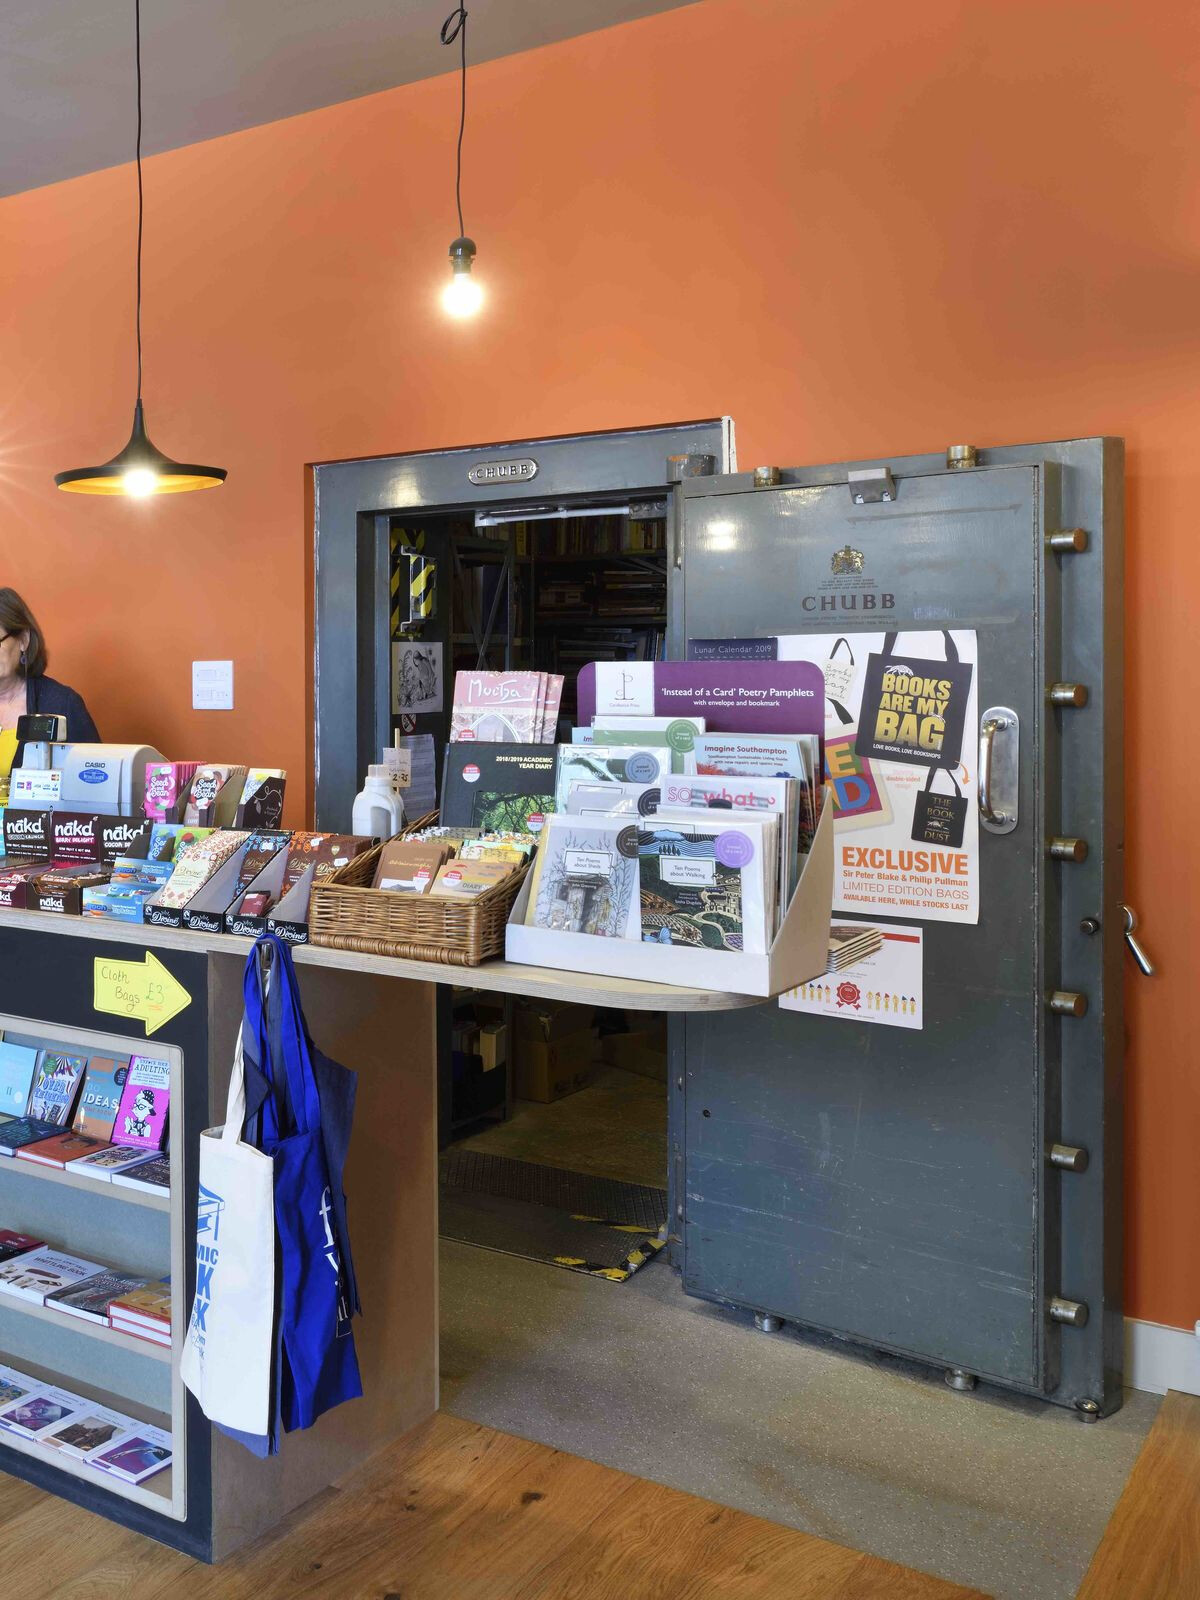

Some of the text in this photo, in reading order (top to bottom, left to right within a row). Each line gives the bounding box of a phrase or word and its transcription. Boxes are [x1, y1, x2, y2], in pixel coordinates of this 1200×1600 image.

[475, 463, 530, 480] CHUBB
[801, 593, 896, 612] CHUBB
[694, 645, 772, 654] Lunar Calendar 2019
[694, 686, 704, 697] of
[738, 687, 767, 698] Poetry
[770, 687, 814, 700] Pamphlets
[881, 672, 952, 700] BOOKS
[708, 700, 734, 708] envelope
[879, 692, 948, 718] ARE MY
[874, 709, 946, 750] BAG
[704, 744, 788, 755] Imagine Southampton
[913, 750, 941, 760] BOOKSHOPS
[932, 796, 952, 806] THE
[927, 806, 955, 820] BOOK
[72, 836, 94, 844] DELIGHT
[924, 831, 950, 842] DUST
[842, 846, 969, 876] EXCLUSIVE
[686, 872, 706, 880] Walking
[843, 869, 968, 887] Sir Peter Blake & Philip Pullman
[462, 882, 482, 890] DIARY
[842, 881, 969, 900] LIMITED EDITION BAGS
[843, 894, 968, 912] AVAILABLE HERE, WHILE STOCKS LAST
[152, 912, 180, 926] Divine
[188, 915, 220, 932] Divine
[232, 920, 264, 937] Divine
[274, 926, 308, 942] Divine
[102, 966, 130, 984] Cloth
[116, 982, 164, 1012] Bags £3
[134, 1064, 170, 1075] ADULTING
[82, 1092, 120, 1110] IDEAS
[34, 1256, 87, 1277] WHITTLING BOOK
